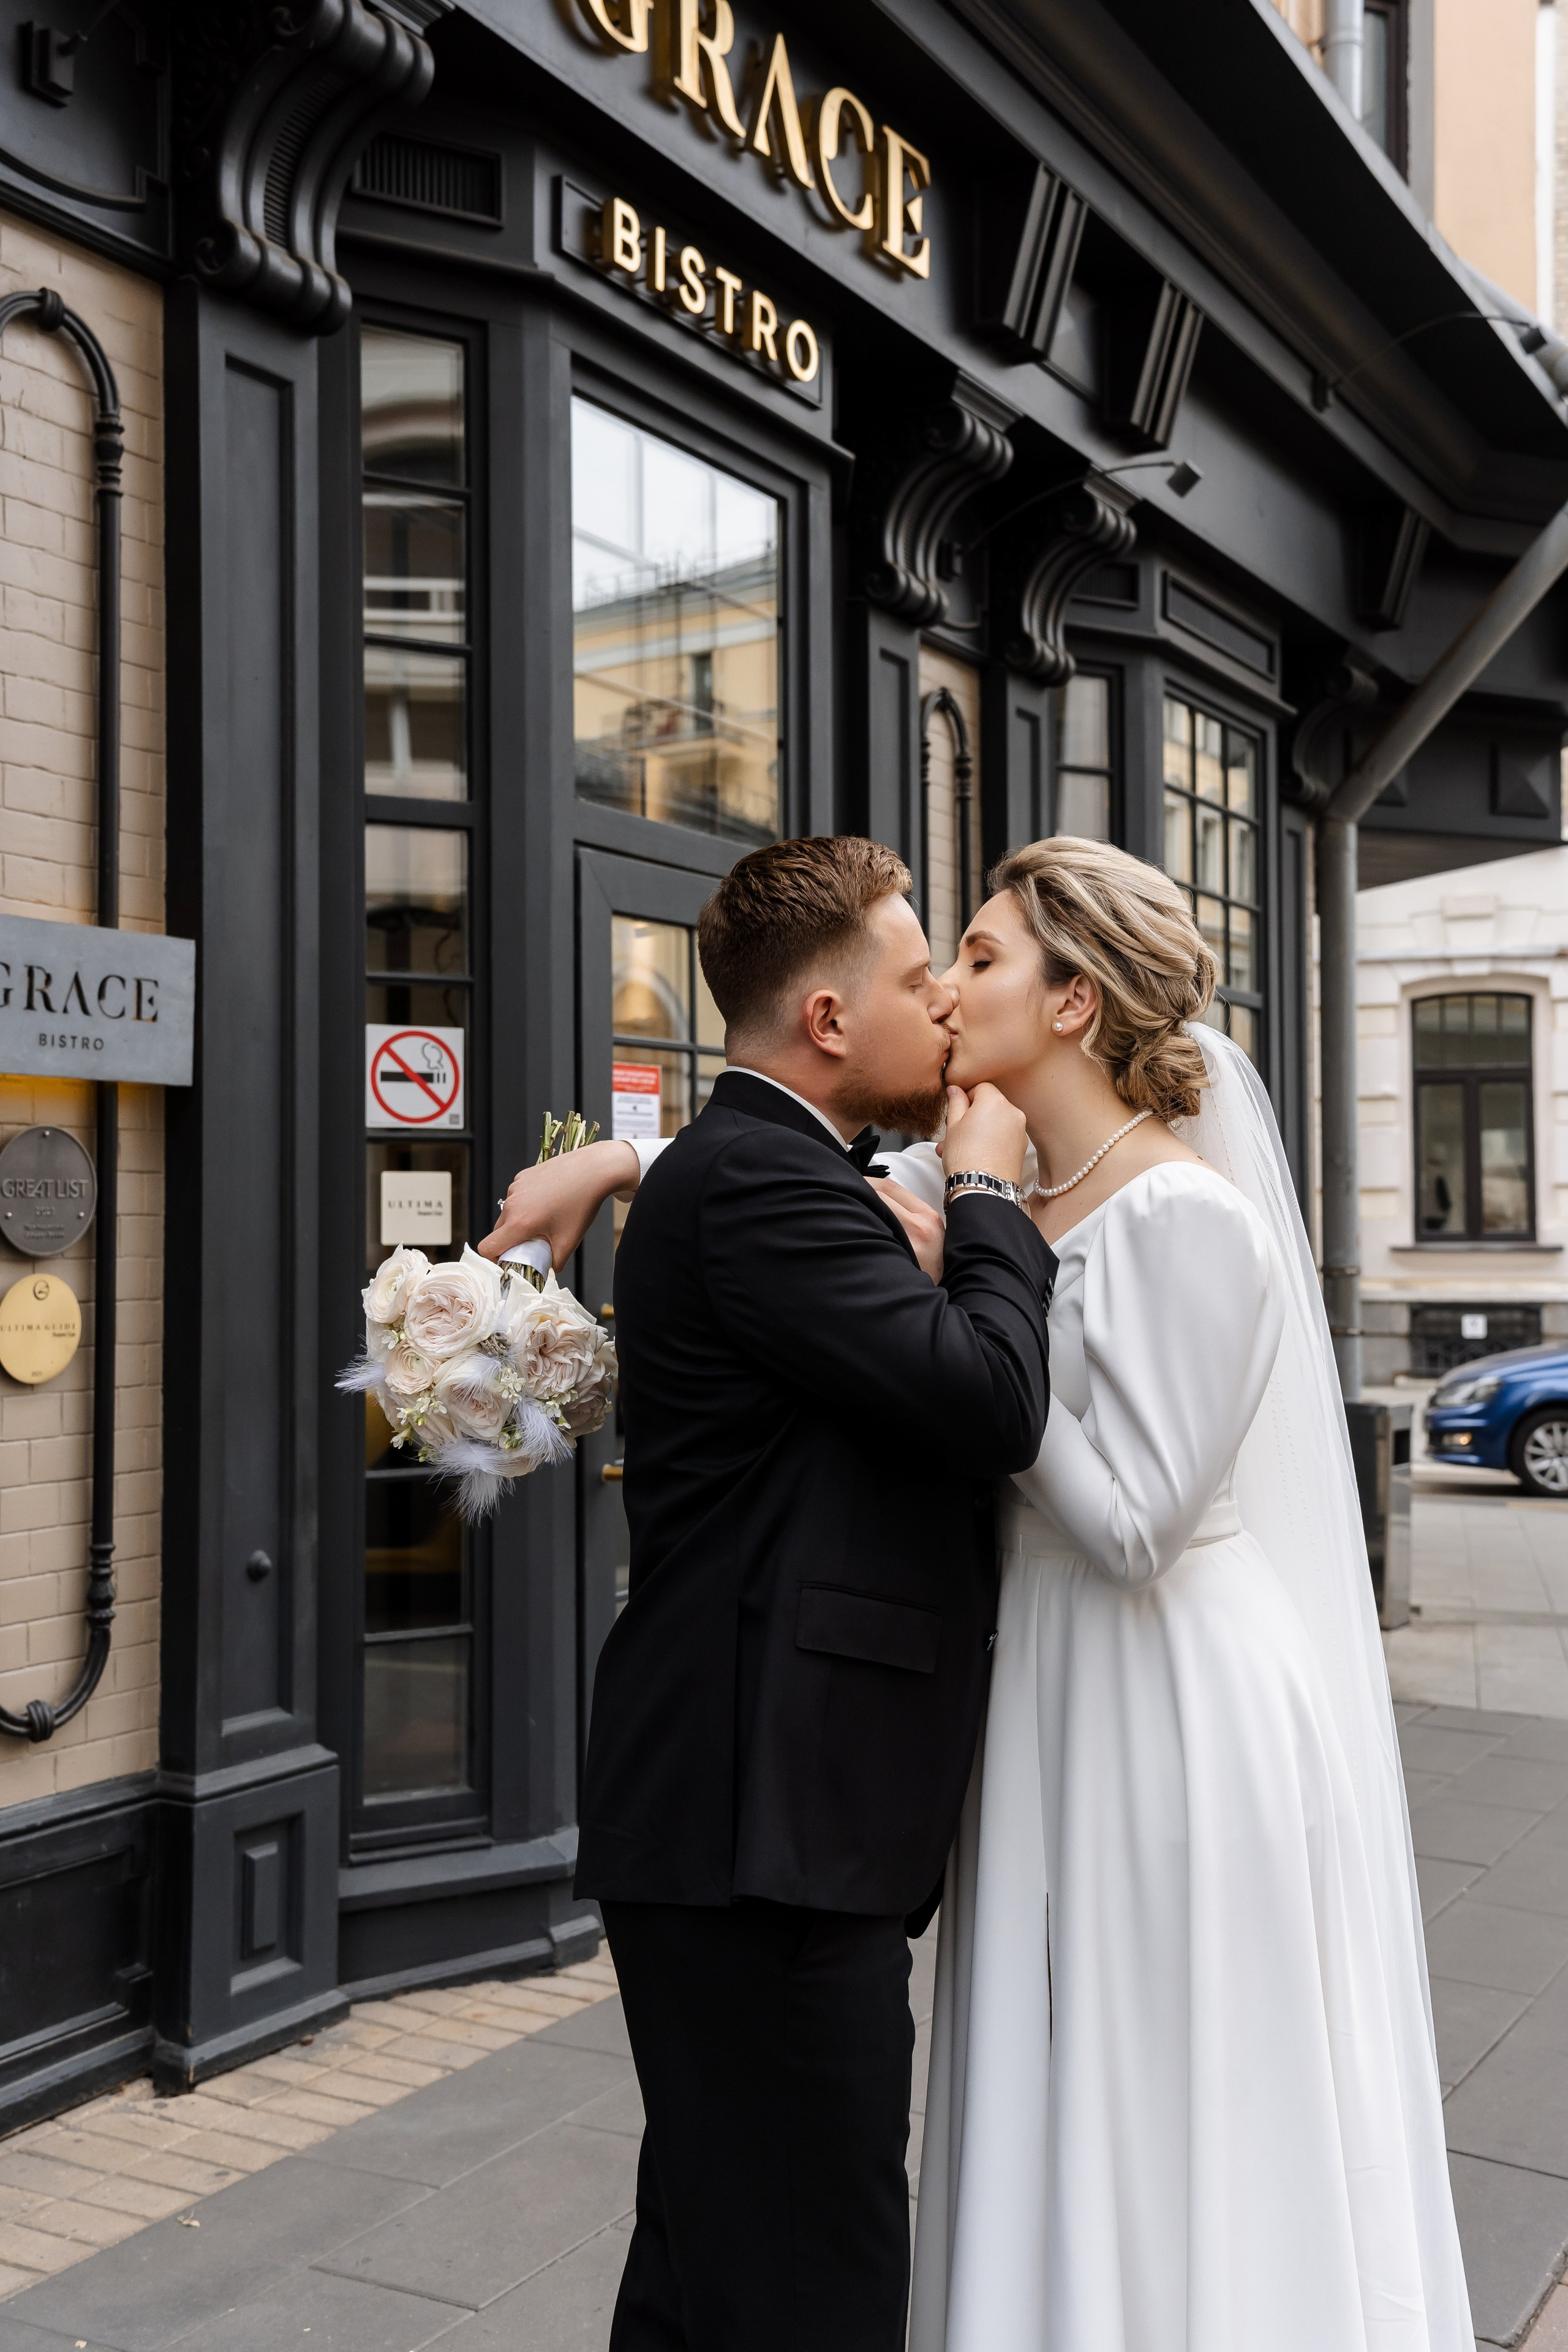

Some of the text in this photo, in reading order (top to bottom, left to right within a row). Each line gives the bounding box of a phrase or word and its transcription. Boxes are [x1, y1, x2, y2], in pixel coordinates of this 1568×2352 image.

[614, 198, 819, 382] BISTRO
[38, 1033, 105, 1052] BISTRO
[388, 1199, 443, 1209] ULTIMA
